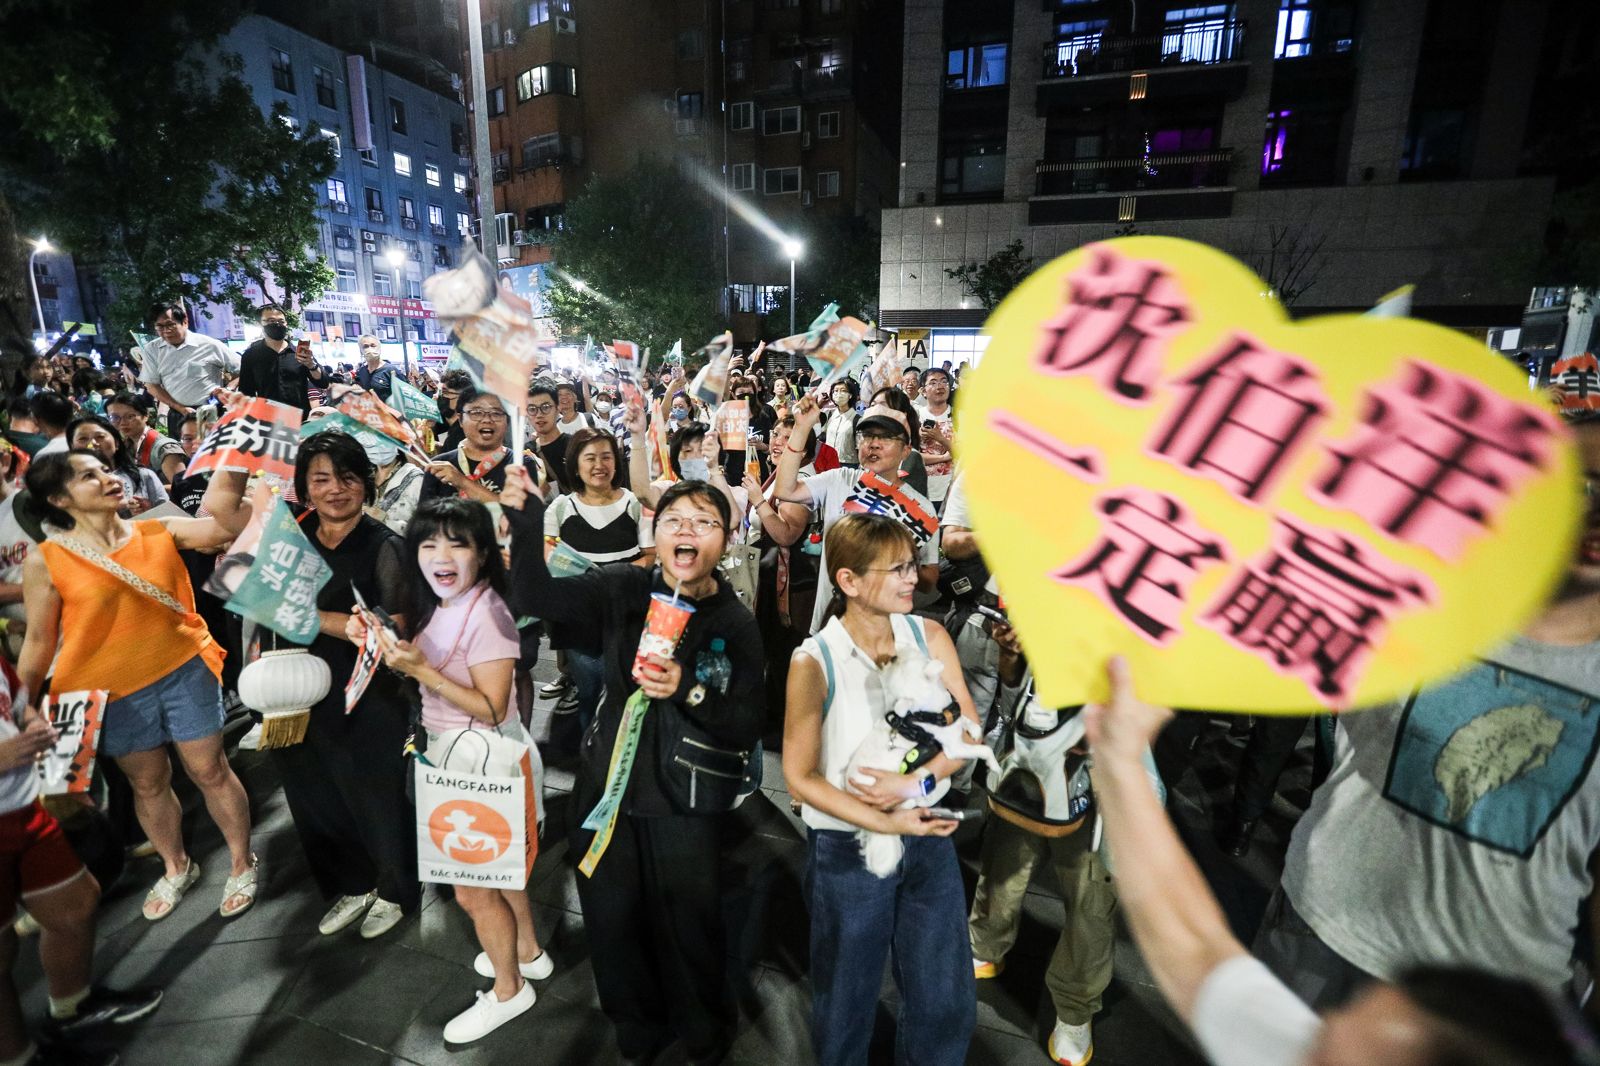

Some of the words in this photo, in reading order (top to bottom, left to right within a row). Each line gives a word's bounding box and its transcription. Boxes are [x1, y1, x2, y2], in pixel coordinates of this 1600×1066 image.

[902, 339, 928, 359] 1A
[1036, 243, 1567, 562] 沈伯洋
[989, 411, 1440, 709] 一定贏
